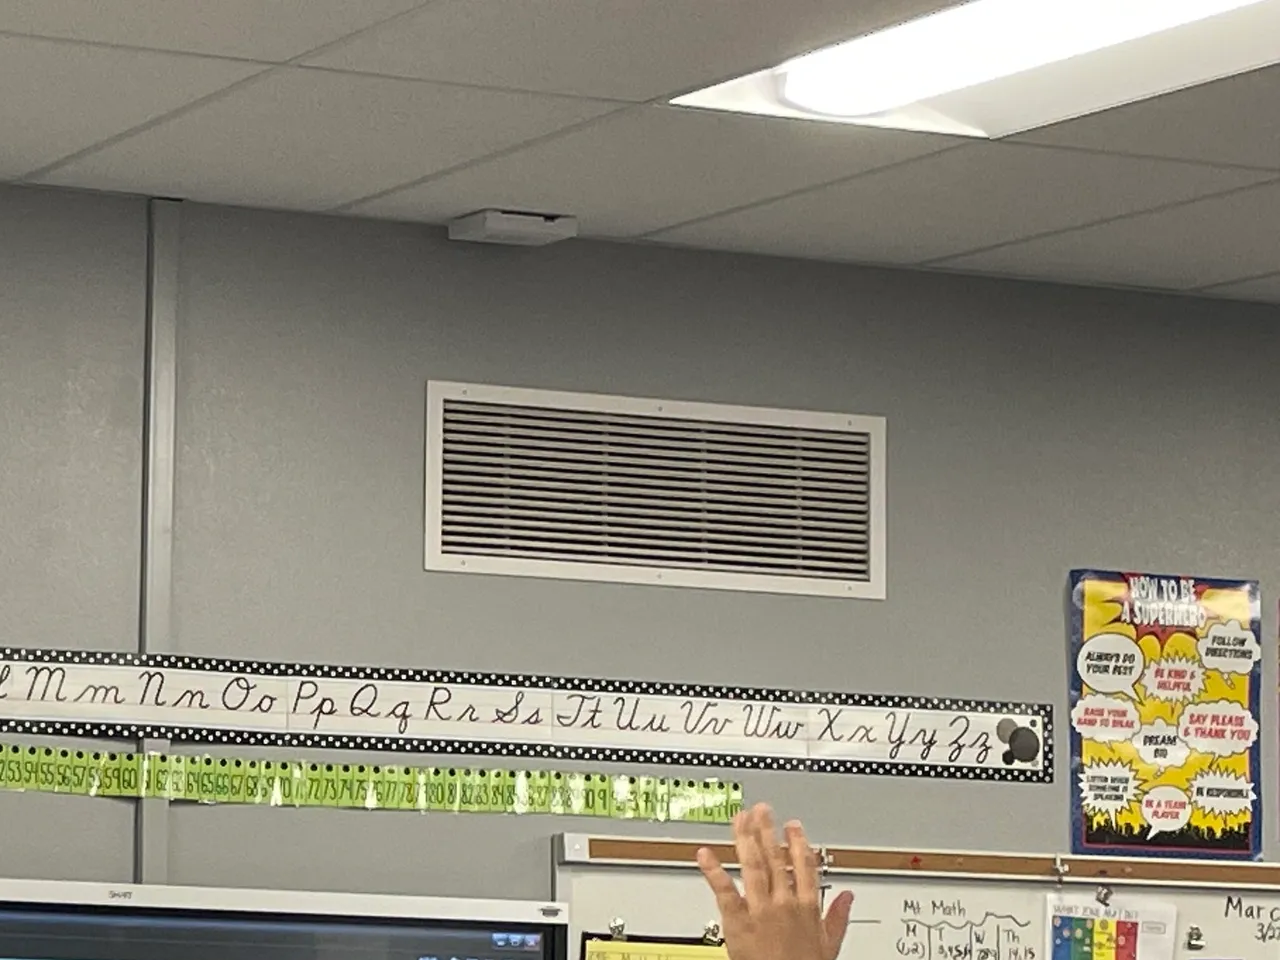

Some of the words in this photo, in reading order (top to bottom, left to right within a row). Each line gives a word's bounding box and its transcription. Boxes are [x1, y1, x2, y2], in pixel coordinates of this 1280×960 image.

[24, 665, 126, 705] Mm
[138, 670, 210, 710] Nn
[220, 676, 277, 713] Oo
[291, 680, 338, 730] Pp
[349, 683, 412, 734] Qq
[424, 686, 479, 722] Rr
[491, 690, 544, 725] Ss
[555, 694, 603, 731] Tt
[613, 696, 670, 734] Uu
[681, 700, 734, 736] Vv
[742, 703, 805, 741] Ww
[817, 708, 878, 745] Xx
[885, 712, 938, 761] Yy
[947, 715, 995, 764] Zz
[932, 900, 966, 917] Math
